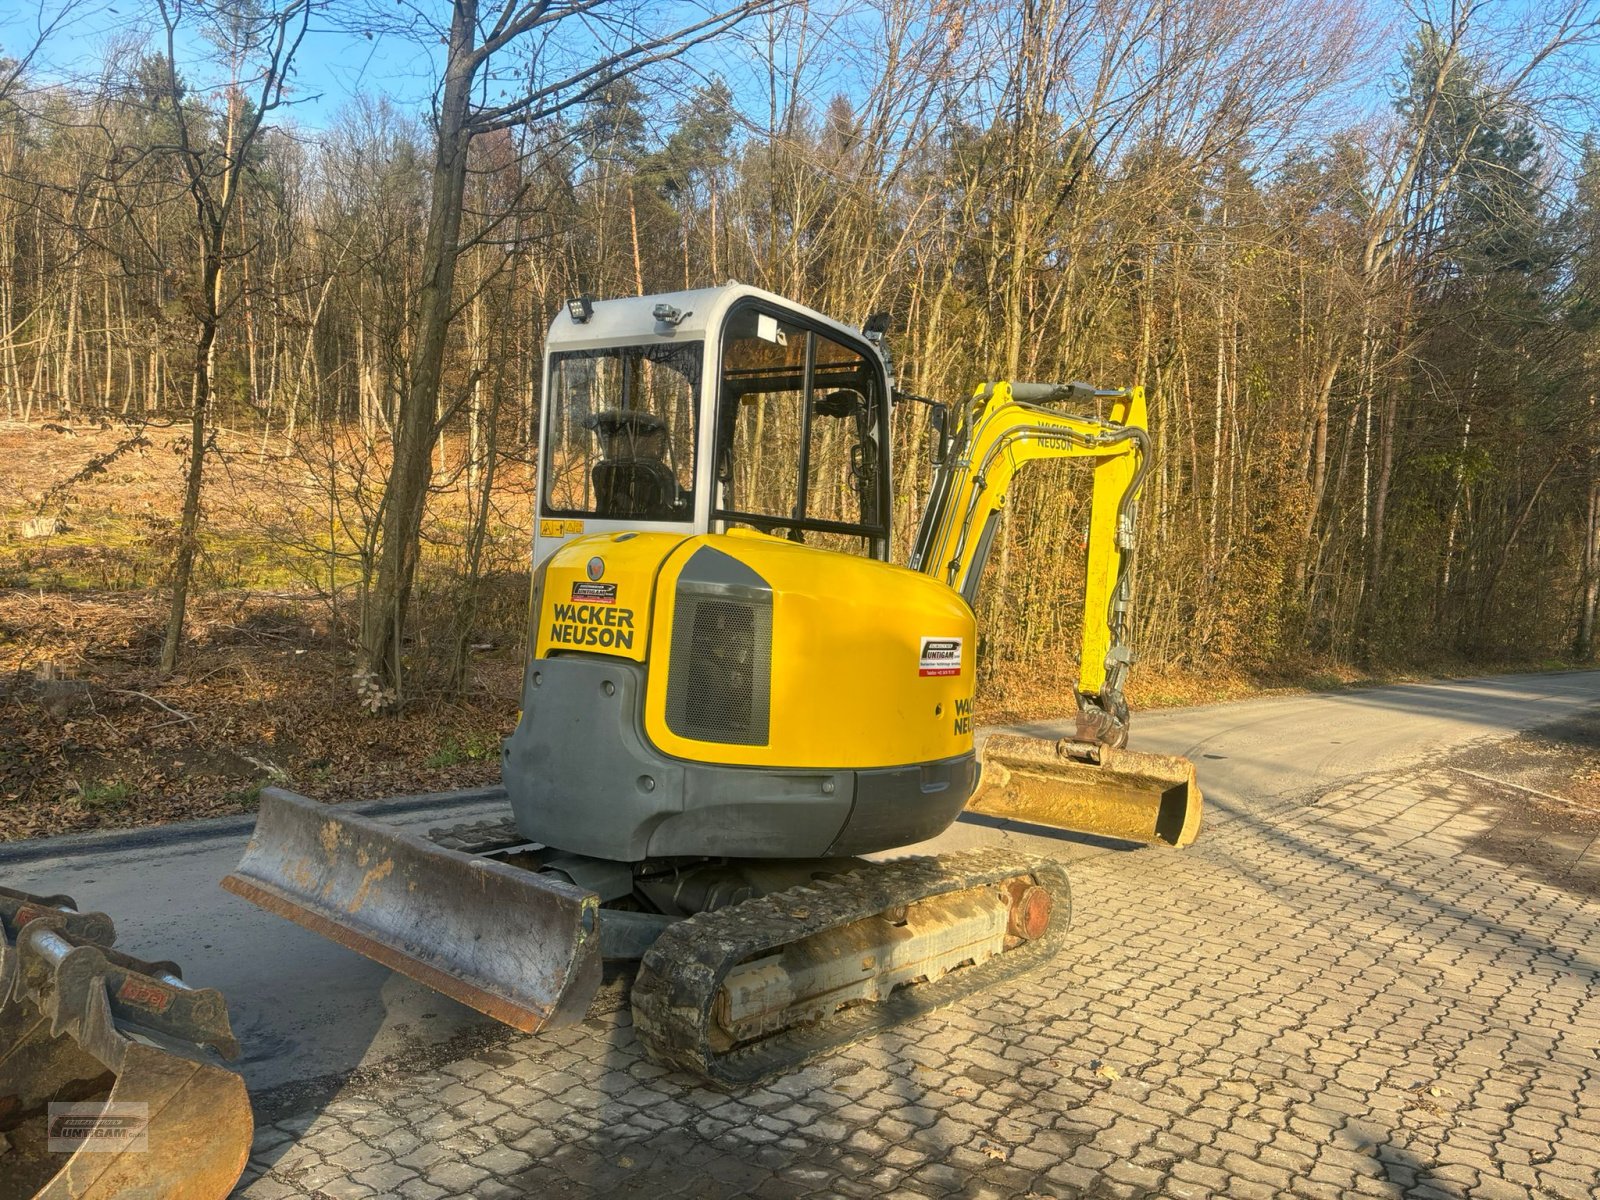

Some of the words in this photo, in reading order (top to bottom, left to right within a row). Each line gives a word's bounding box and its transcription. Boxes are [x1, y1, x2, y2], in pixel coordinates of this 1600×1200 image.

[1037, 435, 1073, 452] NEUSON
[553, 603, 634, 628] WACKER
[550, 623, 634, 649] NEUSON
